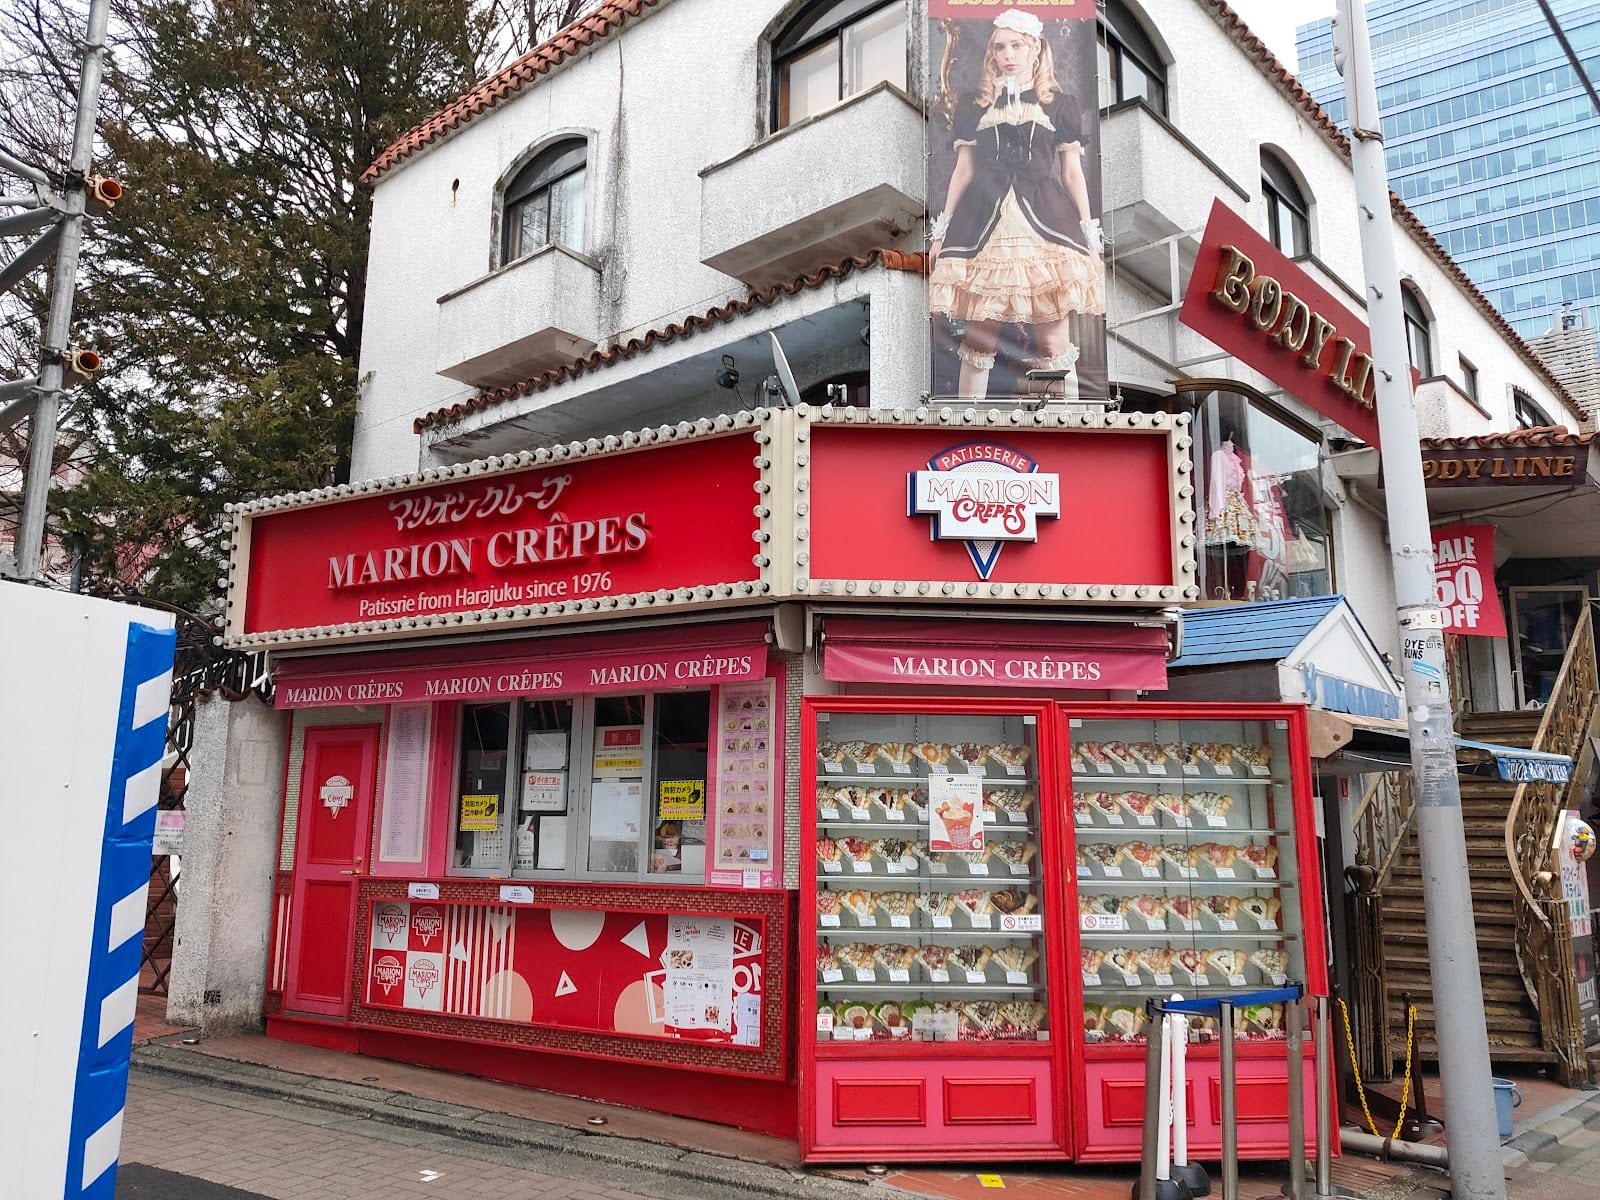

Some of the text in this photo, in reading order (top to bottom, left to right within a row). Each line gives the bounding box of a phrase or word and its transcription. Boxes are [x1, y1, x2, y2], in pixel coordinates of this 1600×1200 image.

[1209, 245, 1377, 410] BODY LI
[941, 445, 1027, 470] PATISSERIE
[1491, 455, 1576, 478] LINE
[927, 478, 1053, 505] MARION
[952, 498, 1026, 535] CREPES
[327, 511, 648, 589] MARION CRÊPES
[358, 571, 612, 618] Patissrie from Harajuku since 1976
[589, 654, 752, 686] MARION CRÊPES
[891, 656, 1101, 681] MARION CRÊPES
[285, 679, 404, 703] MARION CRÊPES
[424, 669, 563, 696] MARION CRÊPES
